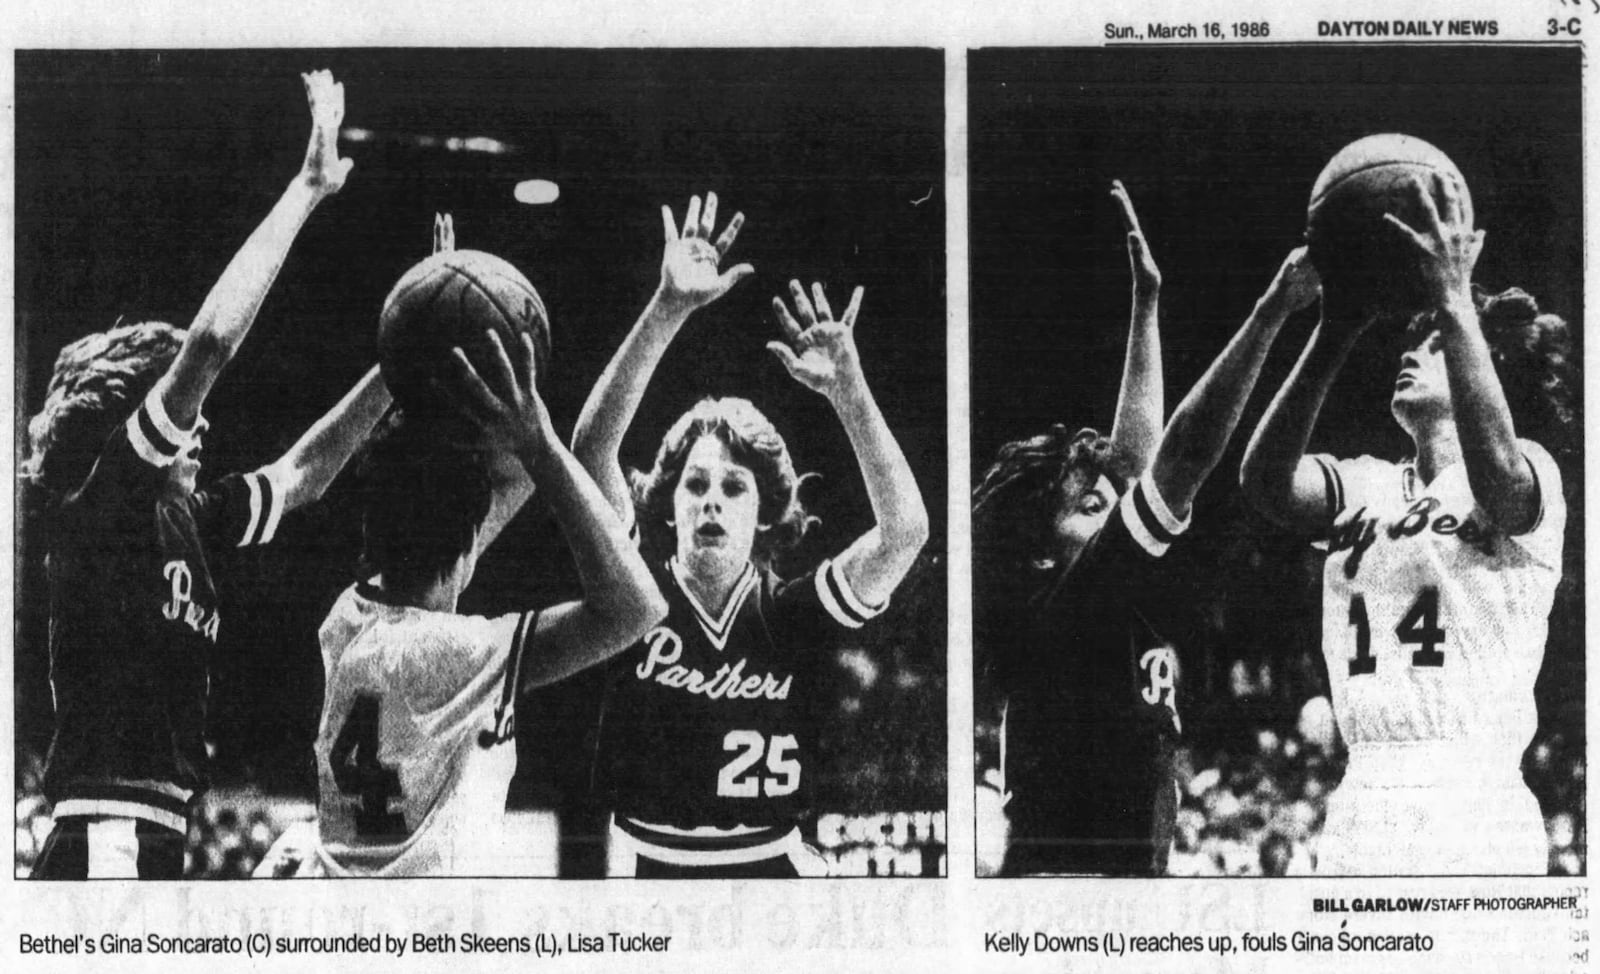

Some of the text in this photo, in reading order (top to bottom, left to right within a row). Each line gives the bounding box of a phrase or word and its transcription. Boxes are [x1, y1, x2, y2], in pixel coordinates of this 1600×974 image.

[1104, 22, 1270, 40] Sun., March 16, 1986
[1318, 20, 1499, 36] DAYTON DAILY NEWS
[1547, 18, 1582, 36] 3-C
[1348, 586, 1446, 676] 14
[637, 627, 793, 700] Panthers
[717, 730, 801, 798] 25
[1313, 897, 1577, 913] BILL GARLOW/STAFF PHOTOGRAPHER
[20, 932, 672, 958] Bethel's Gina Soncarato (C) surrounded by Beth Skeens (L), Lisa Tucker
[985, 931, 1434, 957] Kelly Downs (L) reaches up, fouls Gina Soncarato
